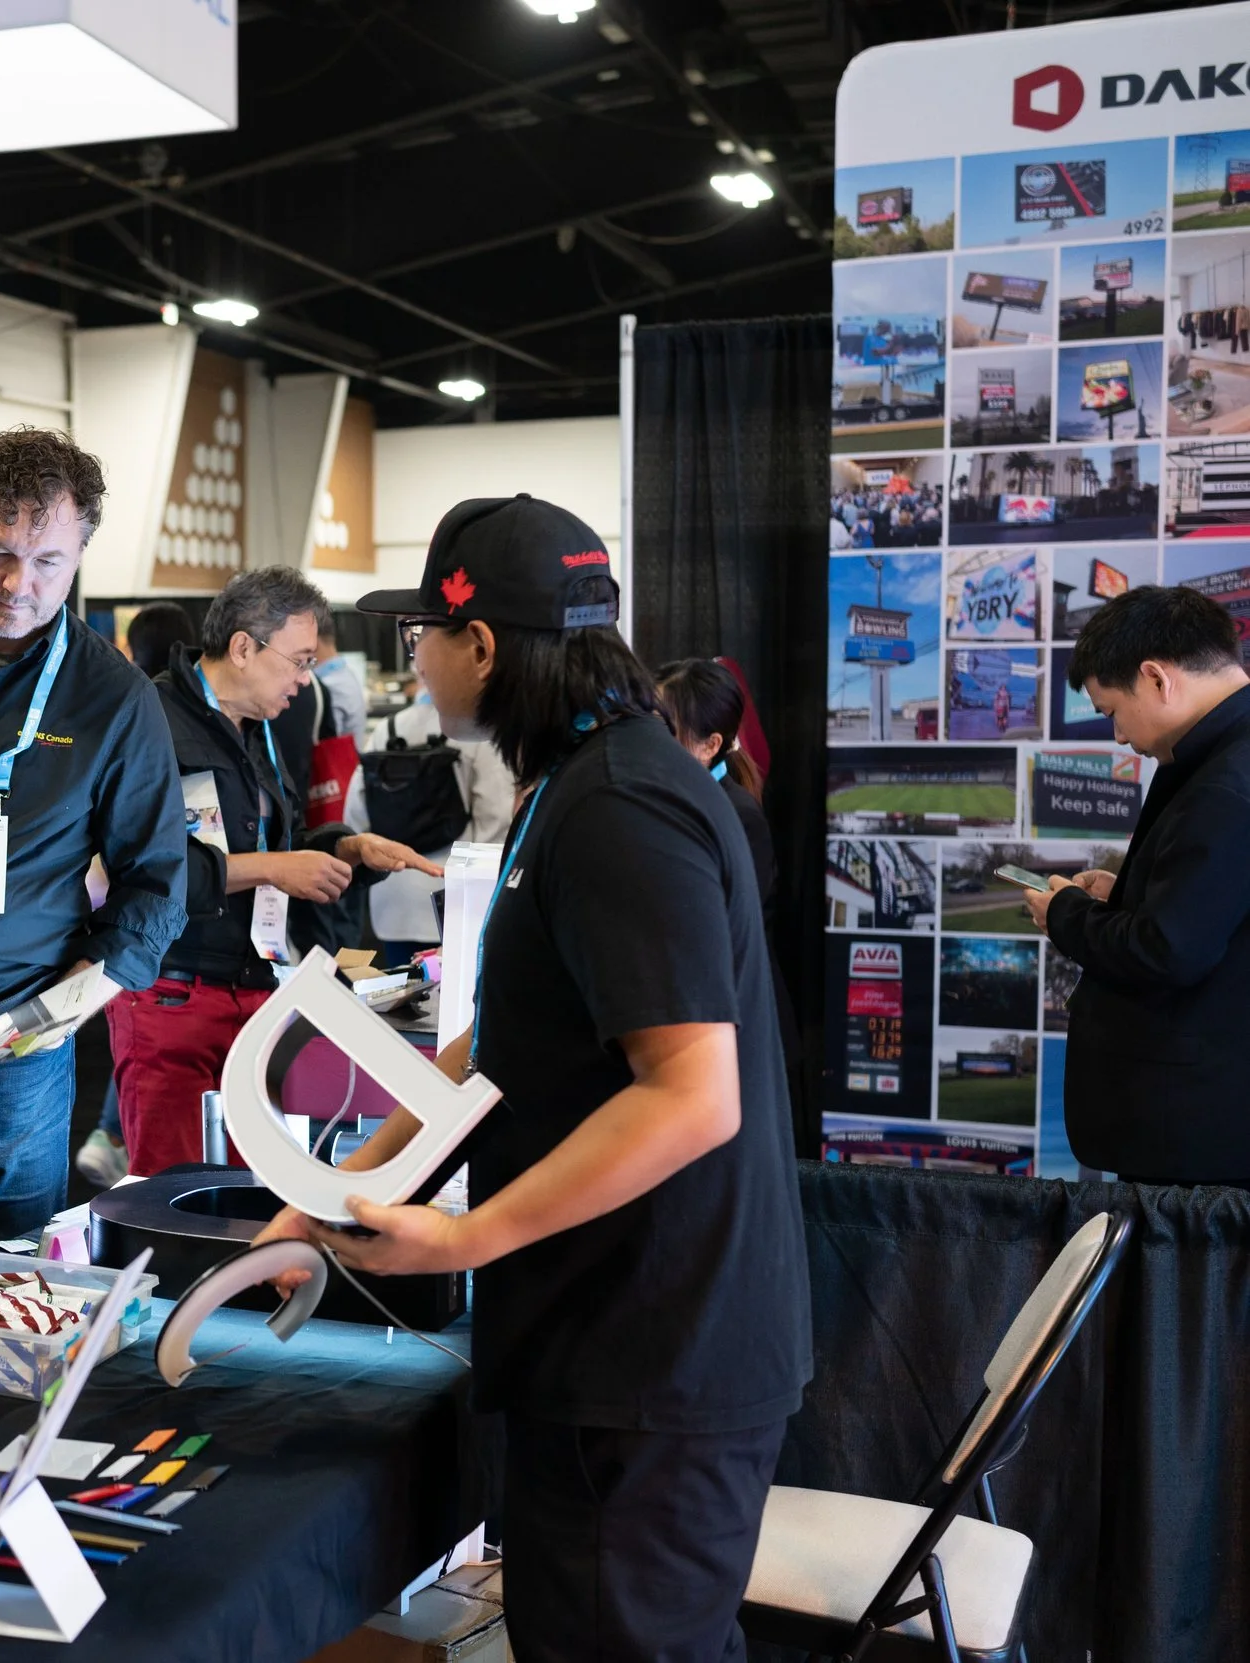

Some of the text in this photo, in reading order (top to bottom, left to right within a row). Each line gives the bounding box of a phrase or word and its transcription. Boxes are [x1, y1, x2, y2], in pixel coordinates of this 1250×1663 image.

[1101, 61, 1250, 109] DAK
[1123, 217, 1165, 236] 4992
[46, 734, 73, 744] Canada
[1043, 773, 1136, 799] Happy Holidays
[1051, 794, 1130, 817] Keep Safe
[945, 1136, 1019, 1154] LOUIS VUITTON
